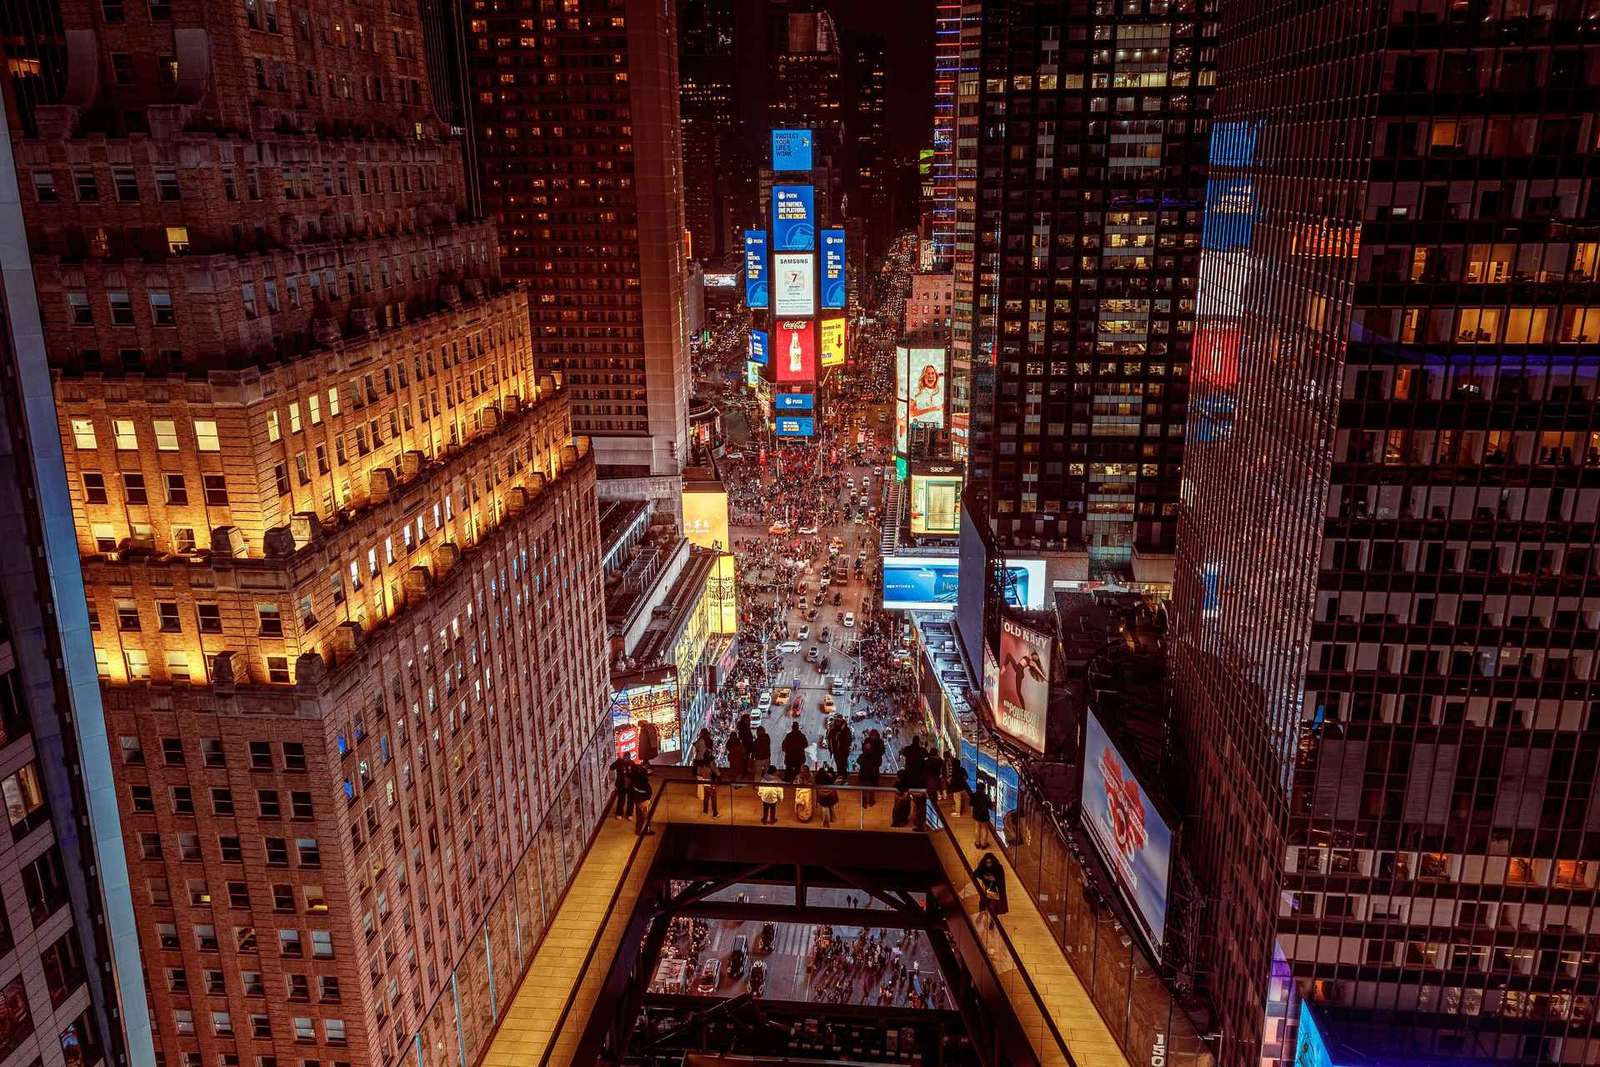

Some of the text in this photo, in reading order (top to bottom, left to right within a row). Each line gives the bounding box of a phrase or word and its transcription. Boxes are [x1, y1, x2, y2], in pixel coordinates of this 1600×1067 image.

[792, 274, 797, 282] 7
[1004, 622, 1047, 649] OLD NAVY
